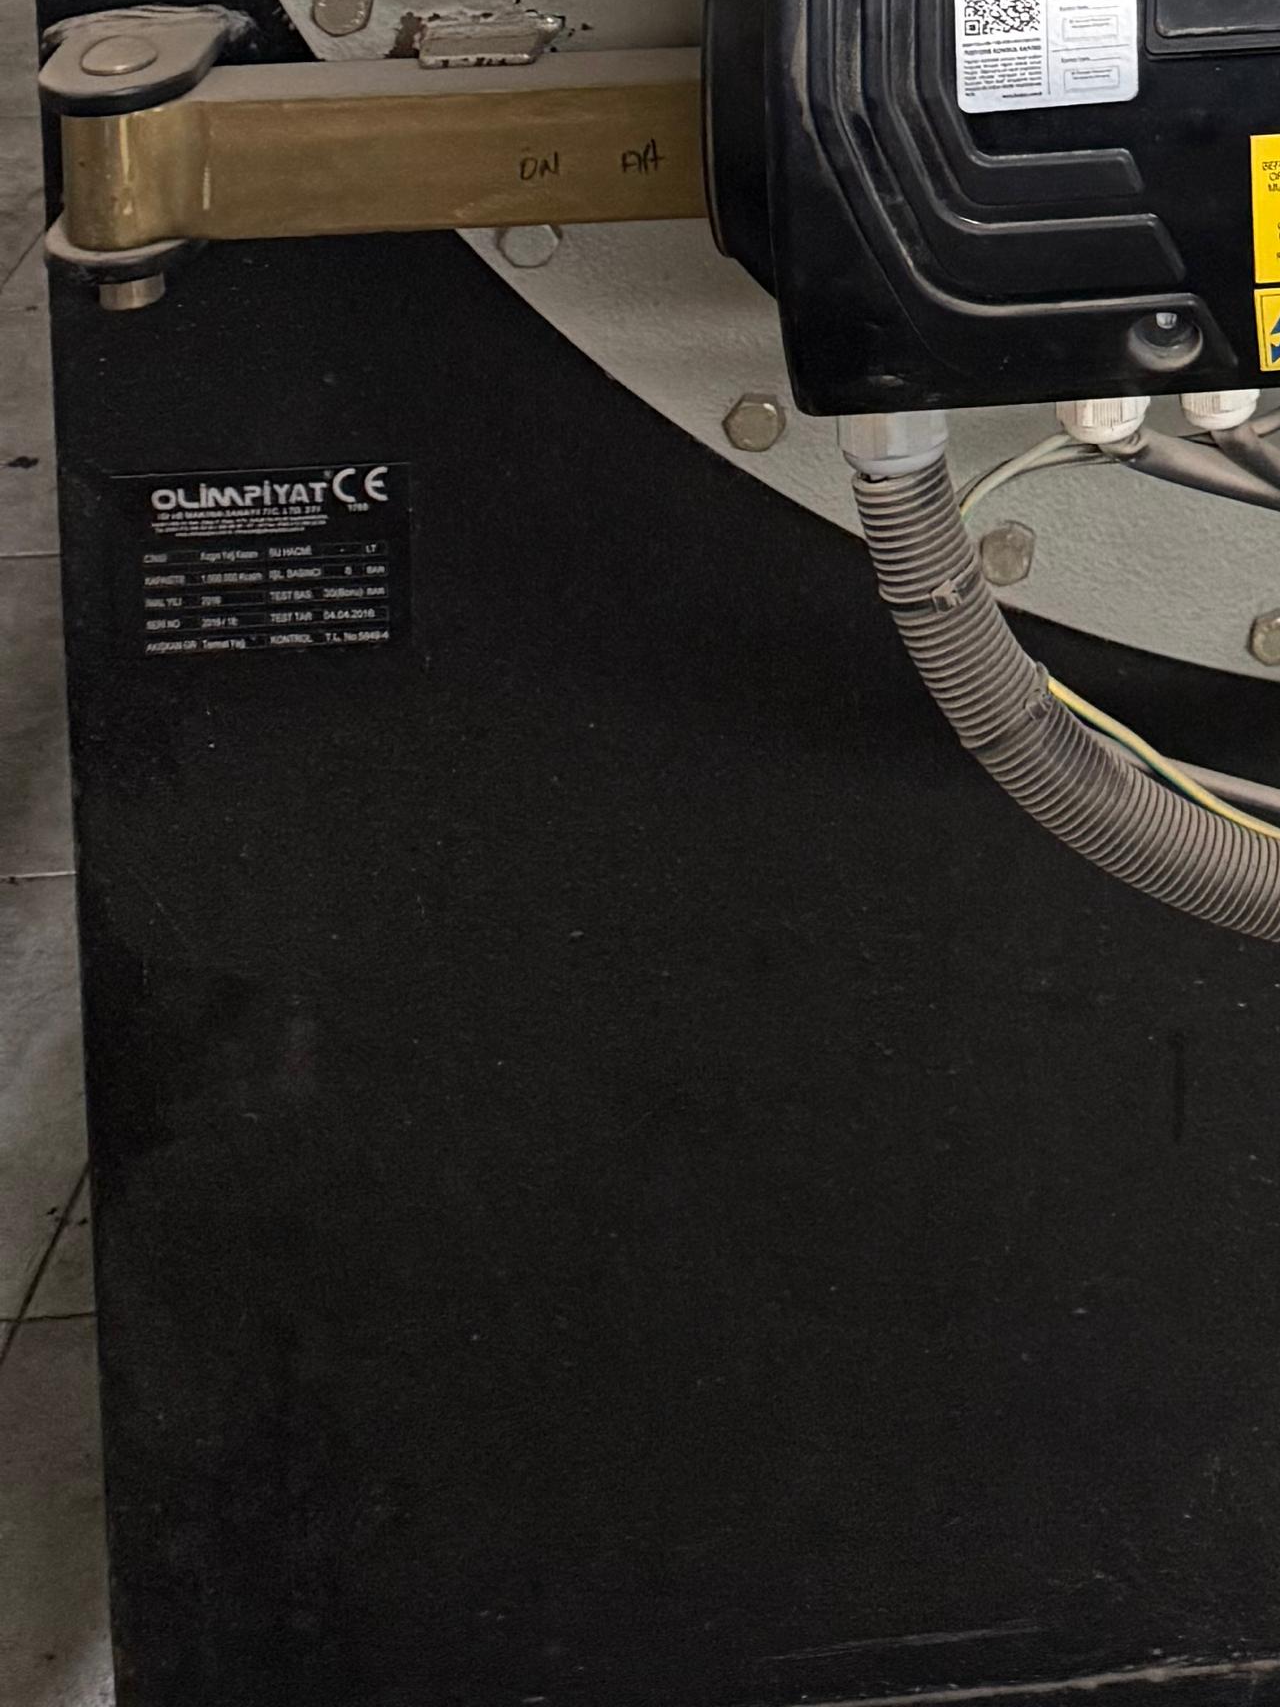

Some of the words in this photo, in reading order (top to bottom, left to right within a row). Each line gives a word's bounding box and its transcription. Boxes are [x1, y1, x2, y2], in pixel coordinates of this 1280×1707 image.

[332, 466, 390, 502] CE
[366, 544, 376, 553] LT
[269, 591, 293, 601] TEST
